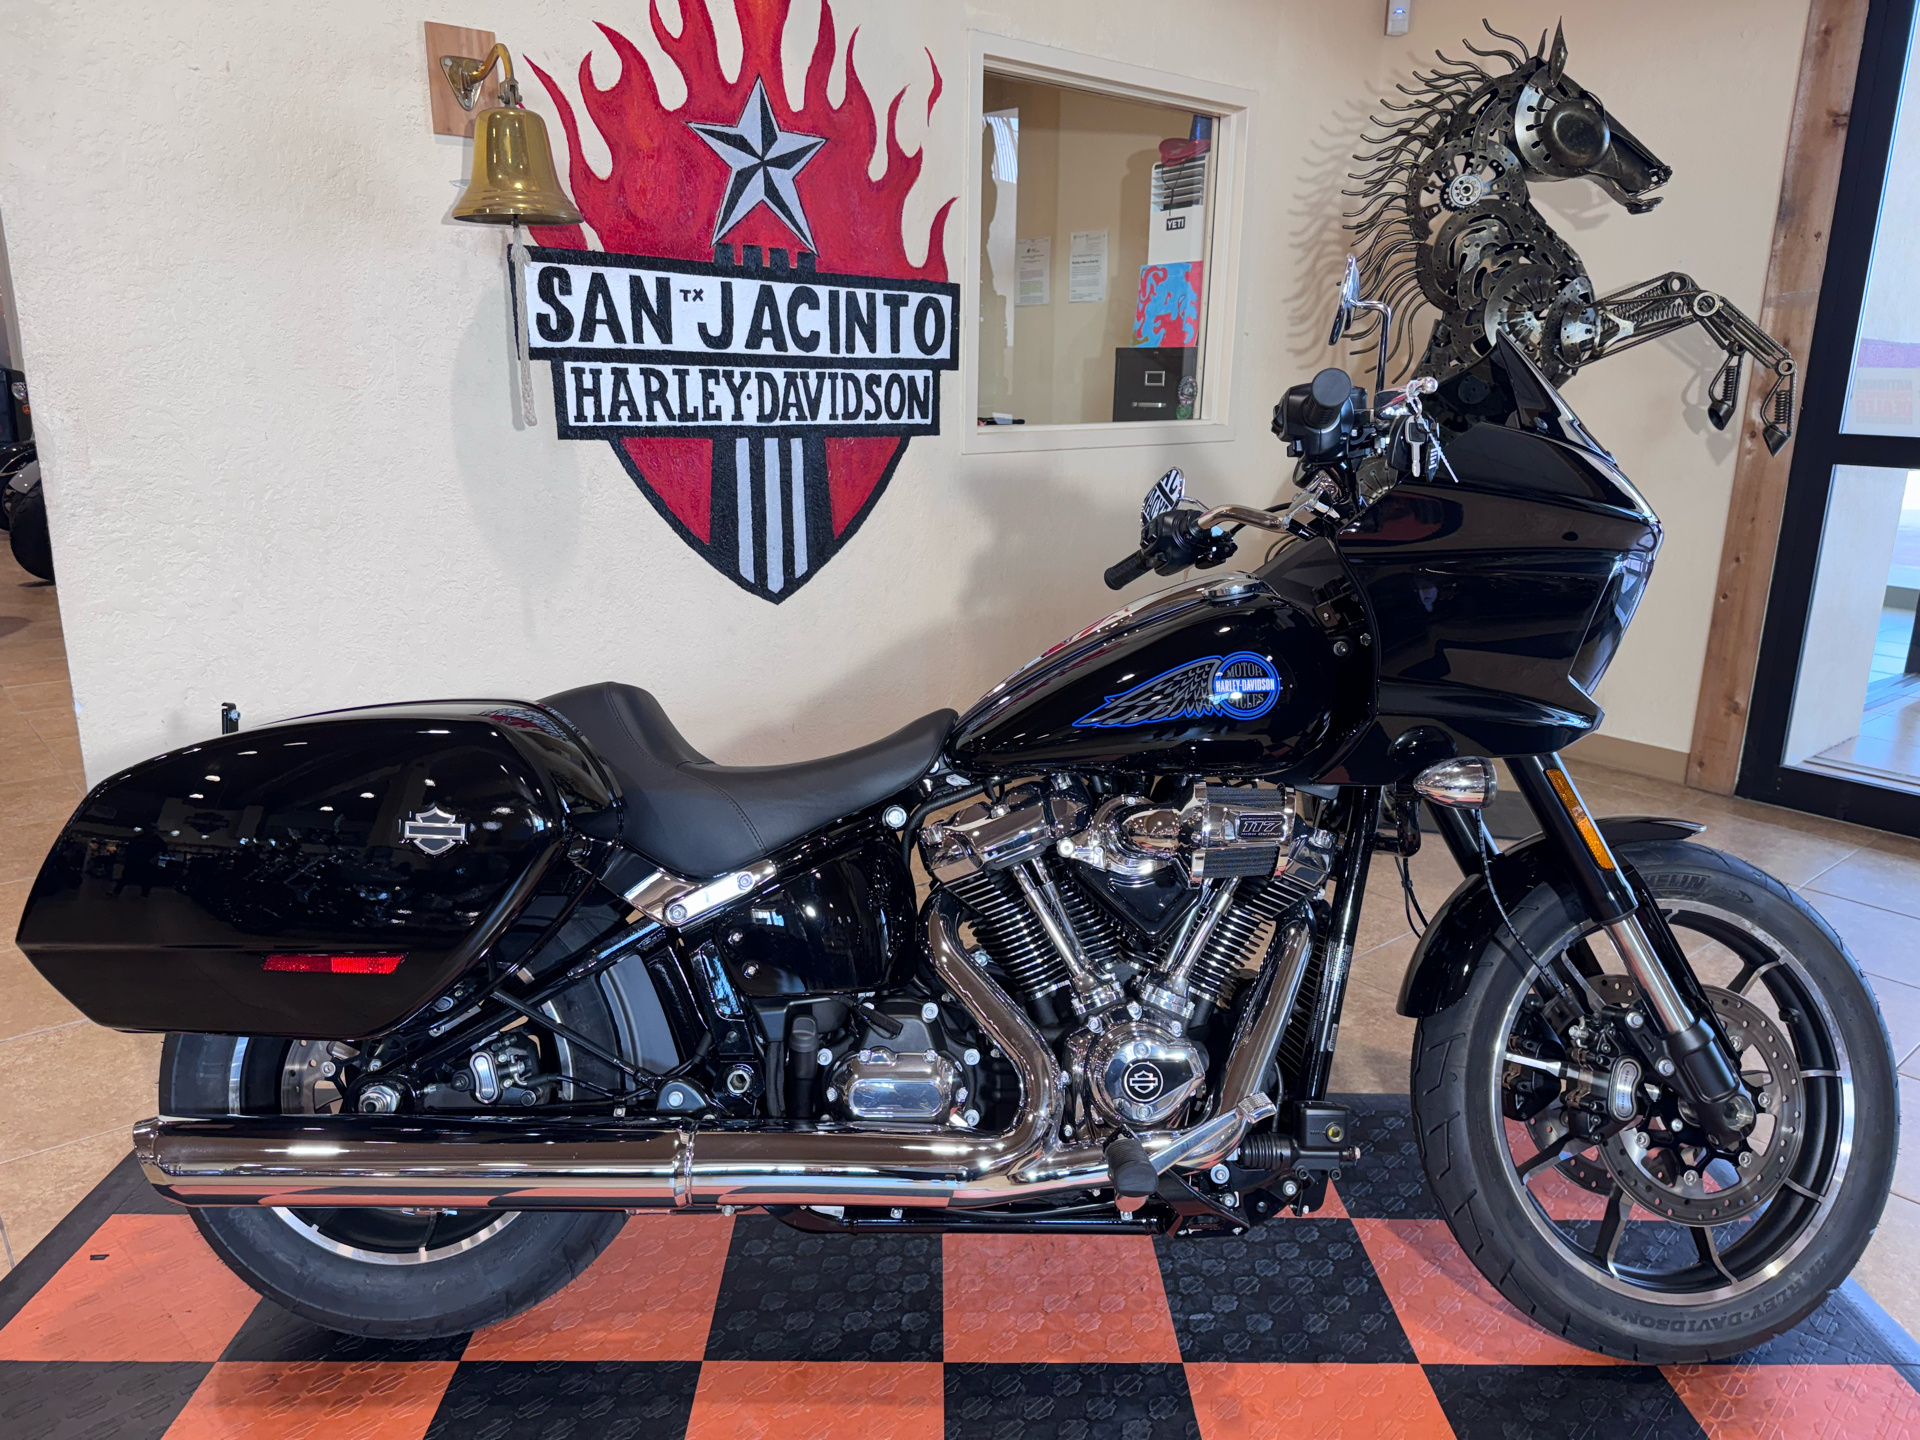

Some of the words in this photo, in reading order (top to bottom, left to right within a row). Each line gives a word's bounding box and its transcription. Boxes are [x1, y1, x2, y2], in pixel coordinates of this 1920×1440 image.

[1167, 218, 1185, 230] YETI
[535, 265, 673, 345] SAN
[679, 288, 704, 303] TX
[697, 281, 946, 356] JACINTO
[1227, 662, 1263, 678] MOTOR
[1215, 678, 1275, 692] HARLEY-DAVIDSON
[1242, 821, 1282, 832] 117
